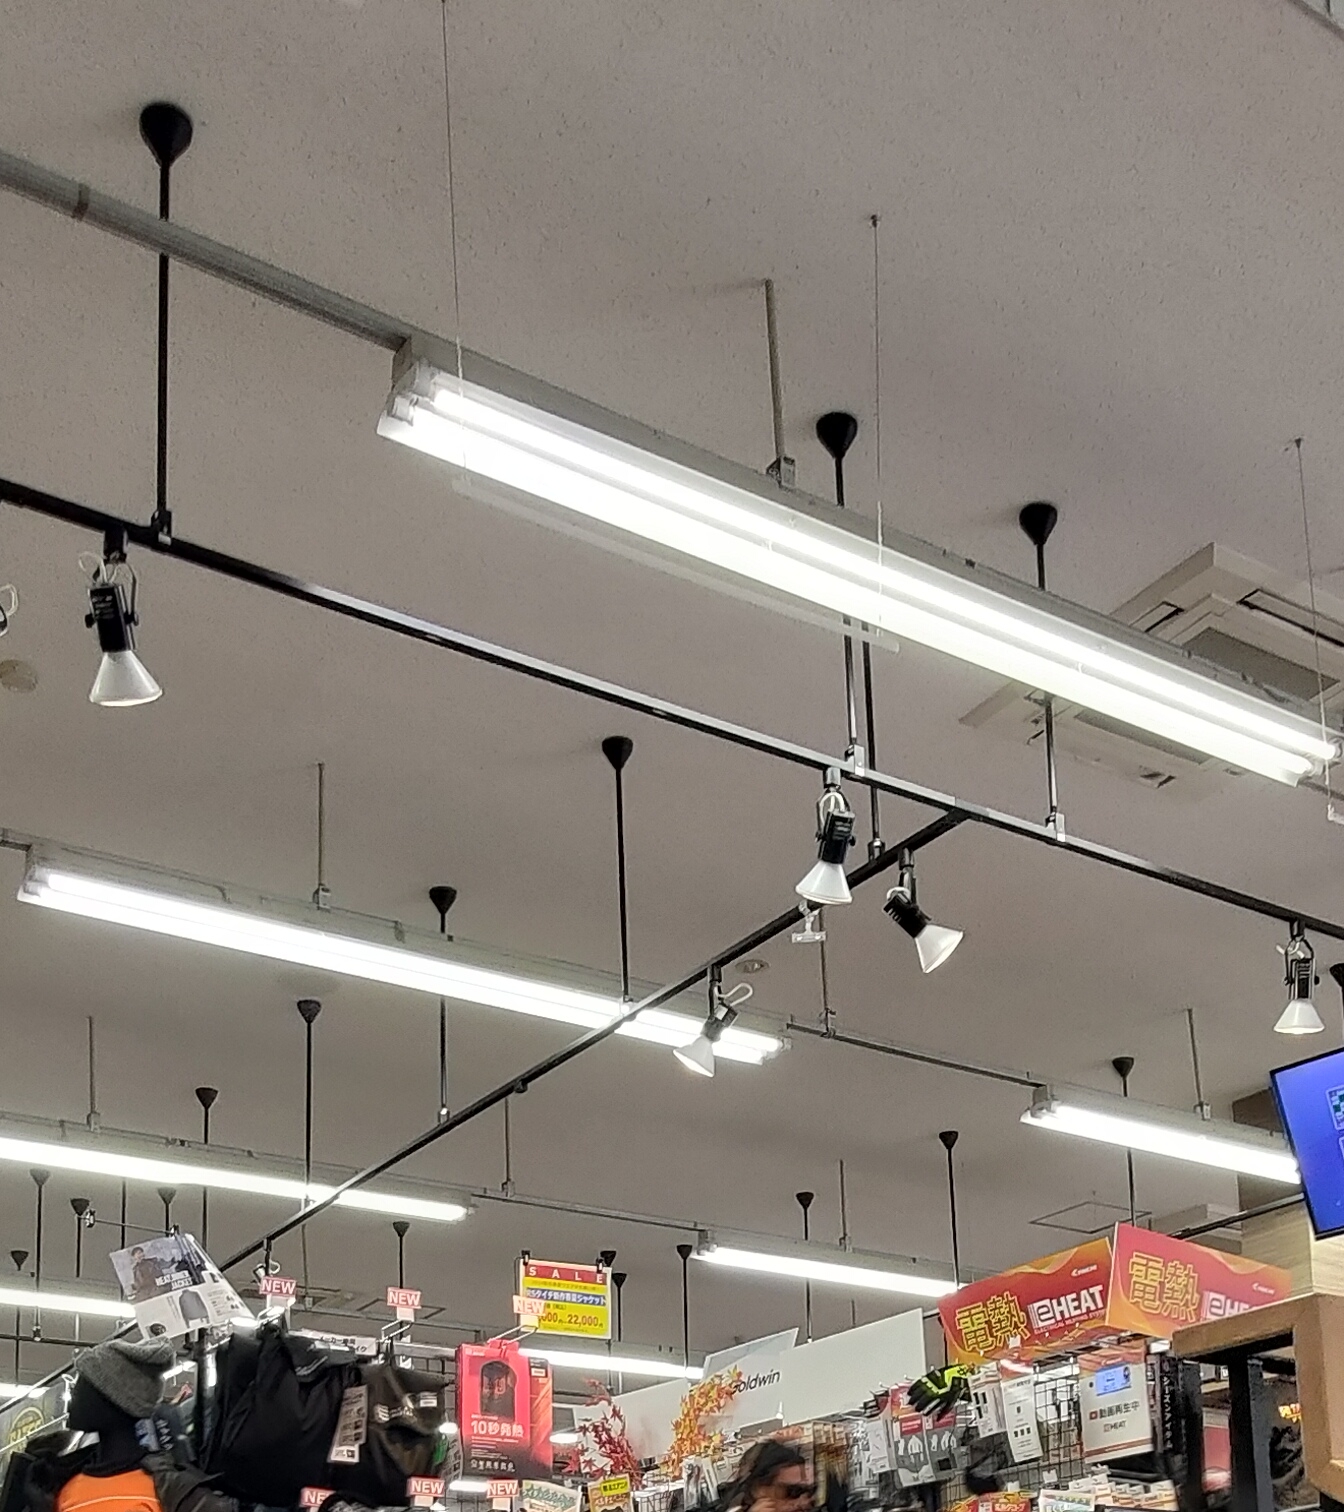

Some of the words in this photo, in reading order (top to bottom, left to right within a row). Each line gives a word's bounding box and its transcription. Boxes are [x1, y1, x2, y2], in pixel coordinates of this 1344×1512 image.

[529, 1266, 604, 1284] SALE
[261, 1278, 295, 1294] NEW
[1129, 1251, 1200, 1323] 電熱
[388, 1290, 420, 1306] NEW
[513, 1299, 545, 1315] NEW
[956, 1291, 1028, 1352] 電熱
[411, 1481, 444, 1495] NEW
[488, 1481, 518, 1496] NEW
